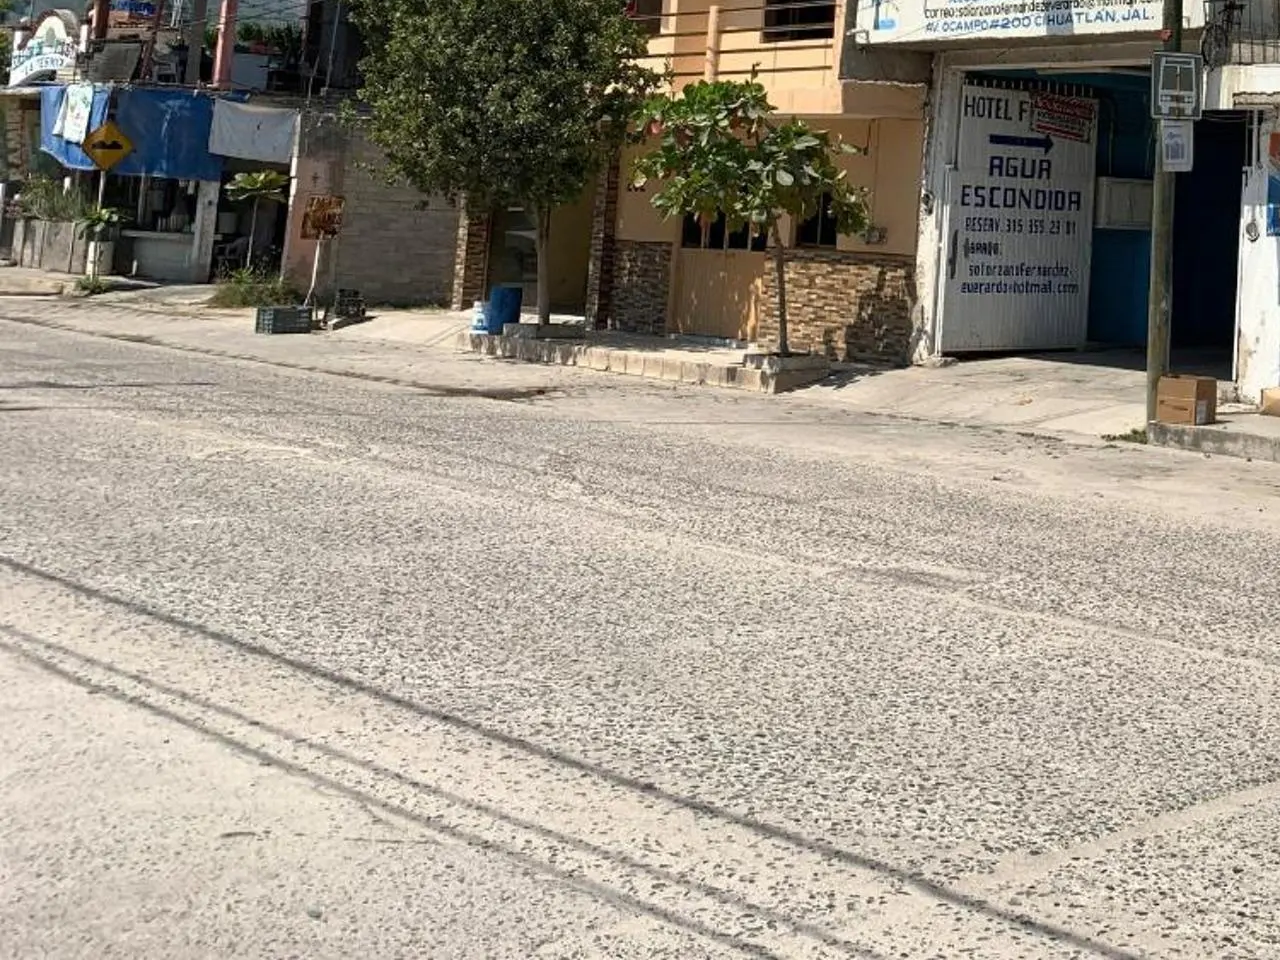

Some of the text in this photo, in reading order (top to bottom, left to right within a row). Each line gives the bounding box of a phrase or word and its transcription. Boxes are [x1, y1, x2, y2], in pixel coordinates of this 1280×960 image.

[1122, 6, 1155, 22] JAL.
[963, 95, 1013, 121] HOTEL
[988, 155, 1052, 180] AGUA
[960, 184, 1082, 212] ESCONDIDA
